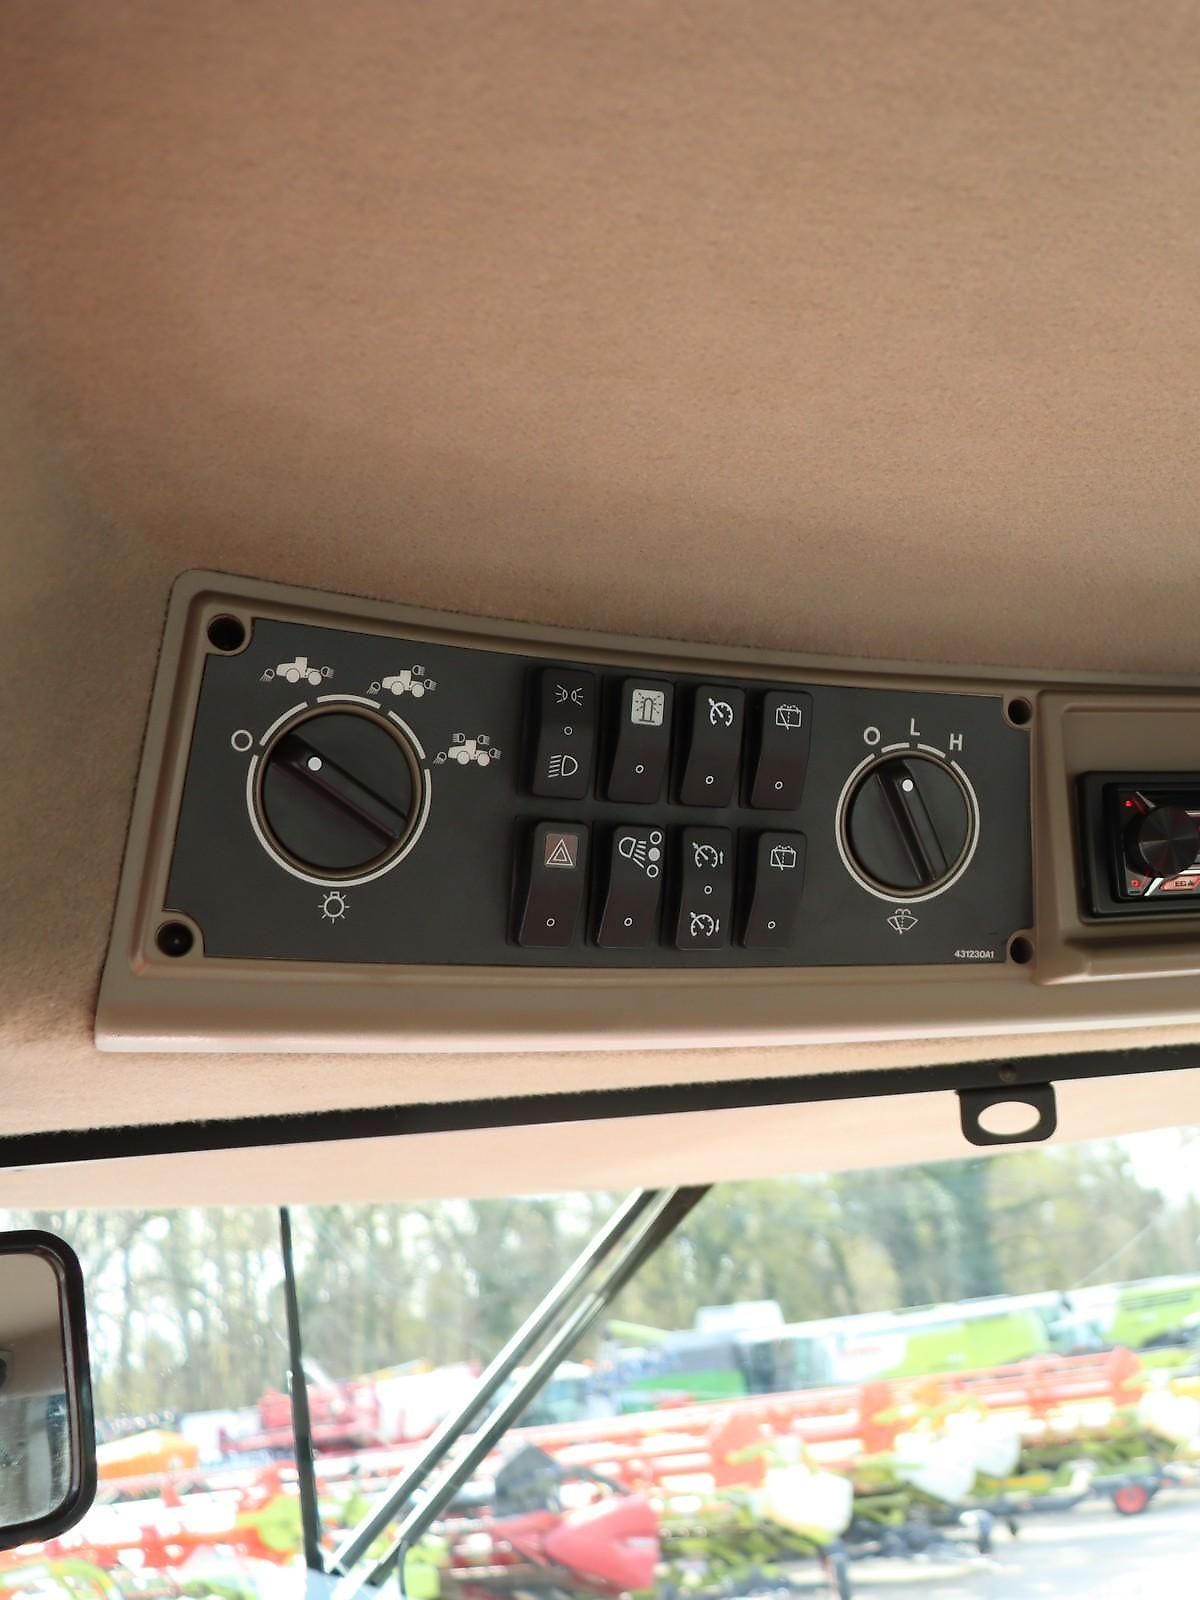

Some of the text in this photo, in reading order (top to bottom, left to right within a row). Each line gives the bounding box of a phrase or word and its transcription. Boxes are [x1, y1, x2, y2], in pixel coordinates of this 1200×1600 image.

[910, 718, 921, 736] L
[949, 733, 963, 752] H
[954, 950, 995, 959] 431230A1
